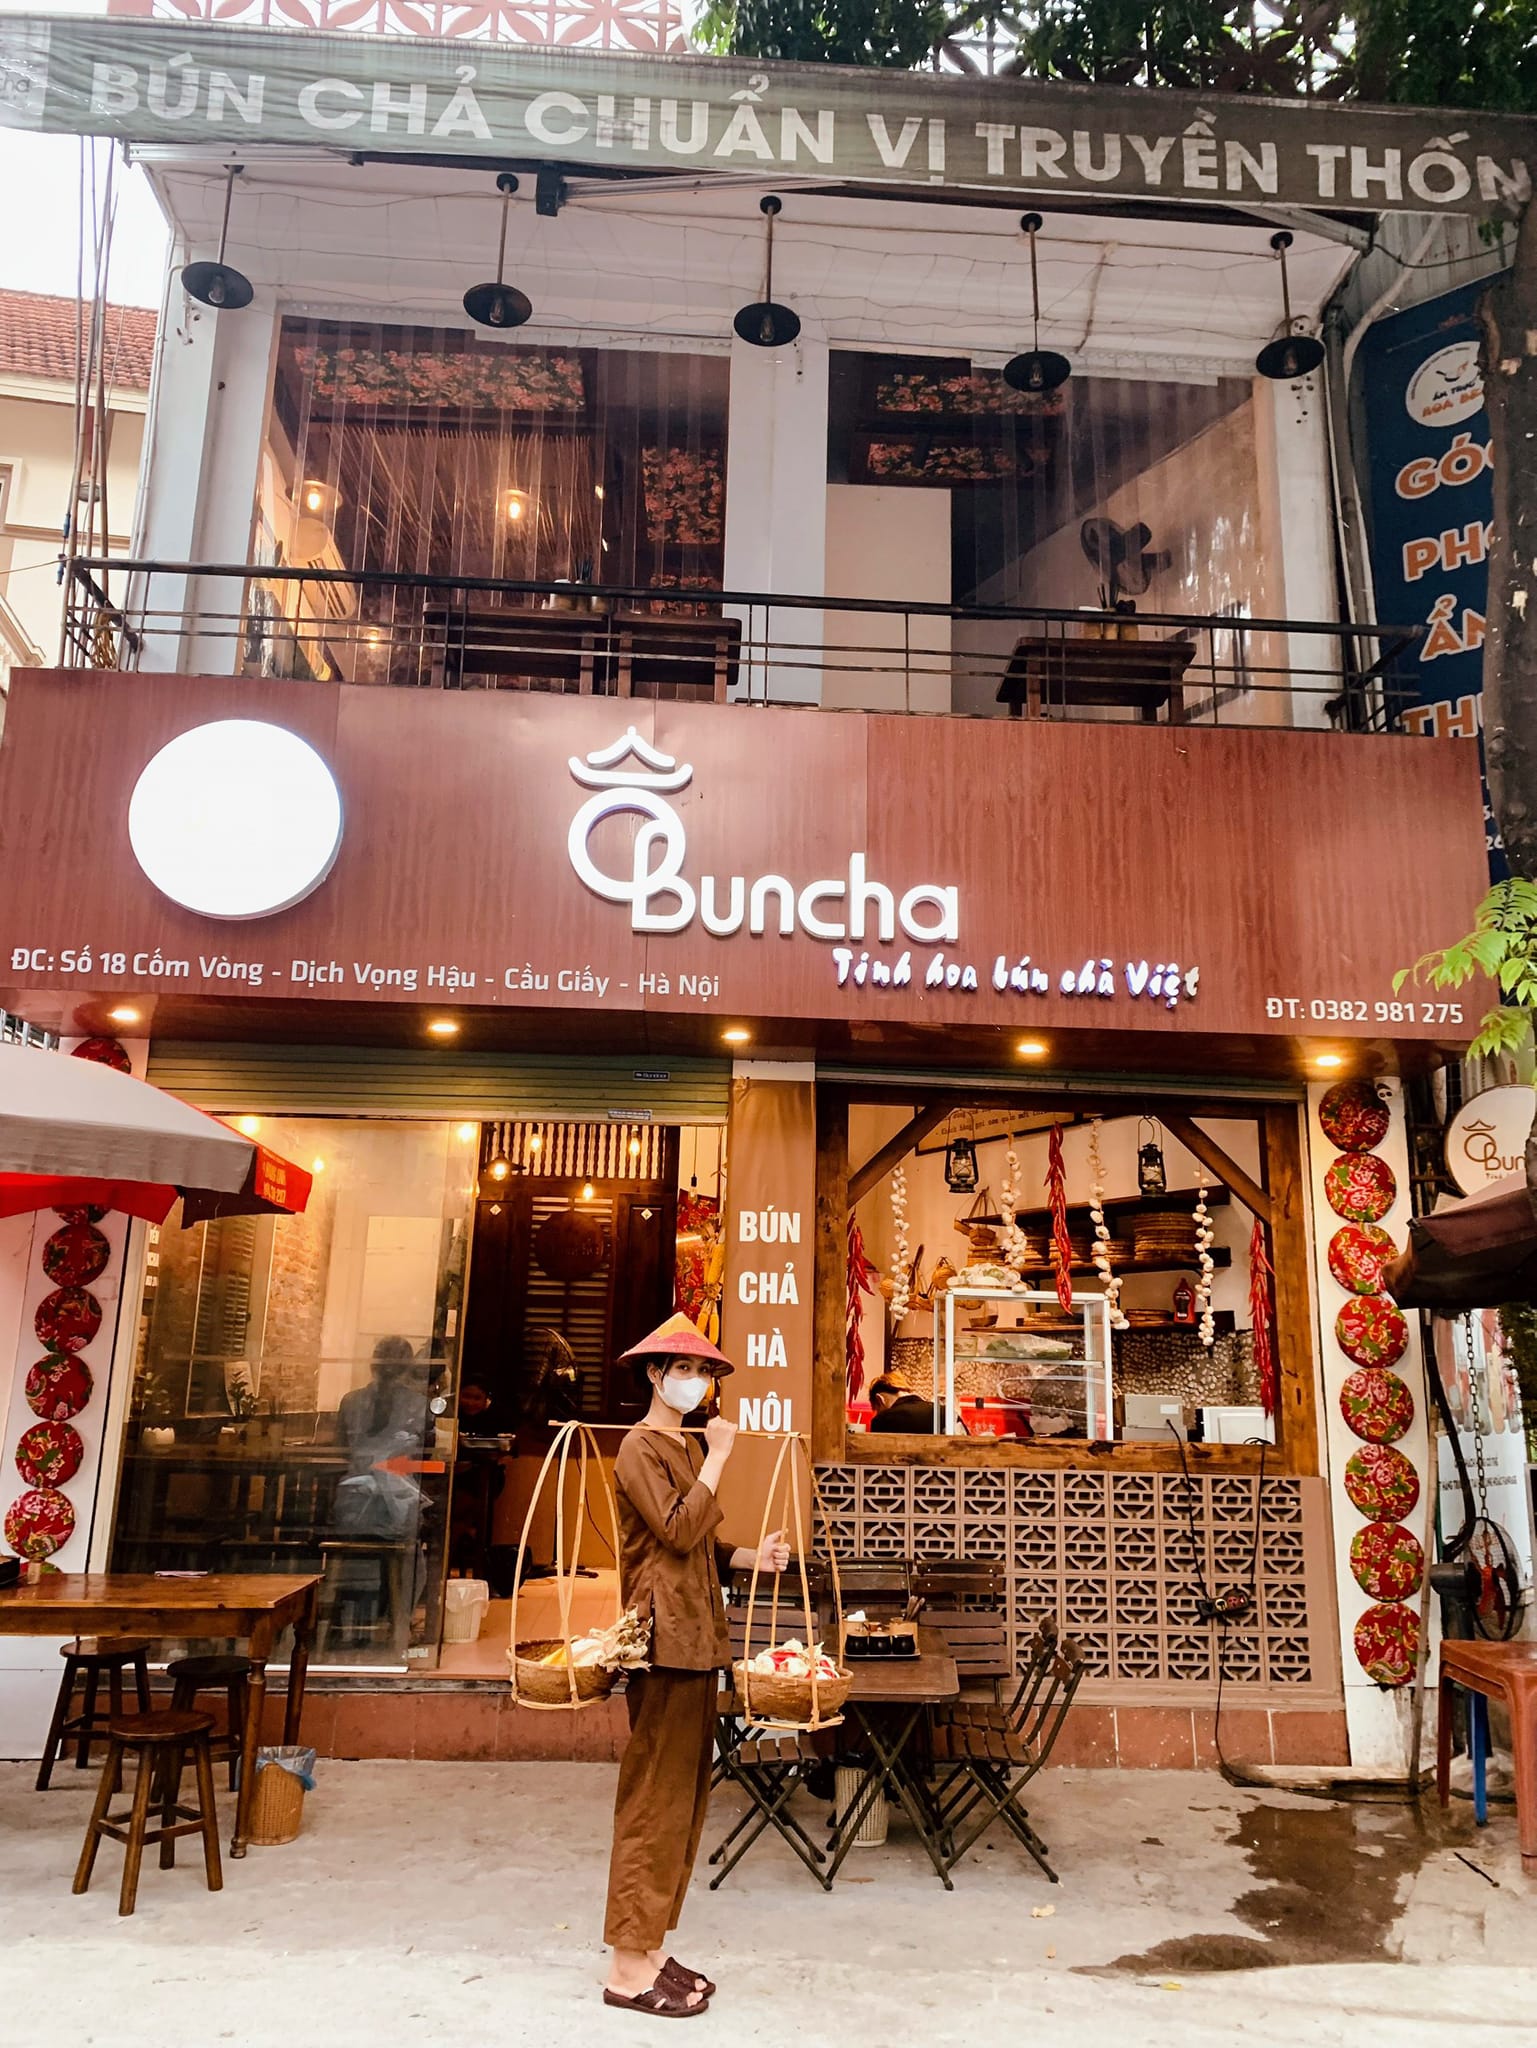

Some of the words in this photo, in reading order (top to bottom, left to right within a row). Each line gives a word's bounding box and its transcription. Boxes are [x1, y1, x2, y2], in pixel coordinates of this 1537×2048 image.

[90, 52, 265, 124] BÚN
[298, 65, 493, 140] CHẢ
[524, 74, 835, 164] CHUẨN
[865, 113, 946, 185] VỊ
[975, 106, 1278, 194] TRUYỀN
[1395, 432, 1494, 500] GÓ
[1402, 519, 1494, 583] PH
[1395, 692, 1483, 738] TH
[11, 948, 54, 971] ĐC:
[60, 945, 92, 973] Số
[100, 953, 126, 975] 18
[133, 948, 190, 977] Cốm
[199, 956, 264, 986] Vòng
[291, 960, 344, 987] Dịch
[354, 962, 417, 991] Vọng
[428, 966, 475, 993] Hậu
[505, 962, 549, 990] Cầu
[557, 965, 609, 997] Giấy
[640, 973, 669, 994] Hà
[679, 974, 719, 1002] Nội
[832, 948, 911, 987] Tinh
[925, 953, 978, 991] hoa
[993, 955, 1049, 994] bún
[1125, 959, 1200, 1010] Việt
[1266, 998, 1305, 1019] ĐT:
[1311, 1000, 1368, 1021] 0382
[1375, 1002, 1415, 1022] 981
[1421, 1003, 1464, 1024] 275
[739, 1205, 800, 1243] BÚN
[738, 1262, 799, 1305] CHẢ
[747, 1328, 787, 1368] HÀ
